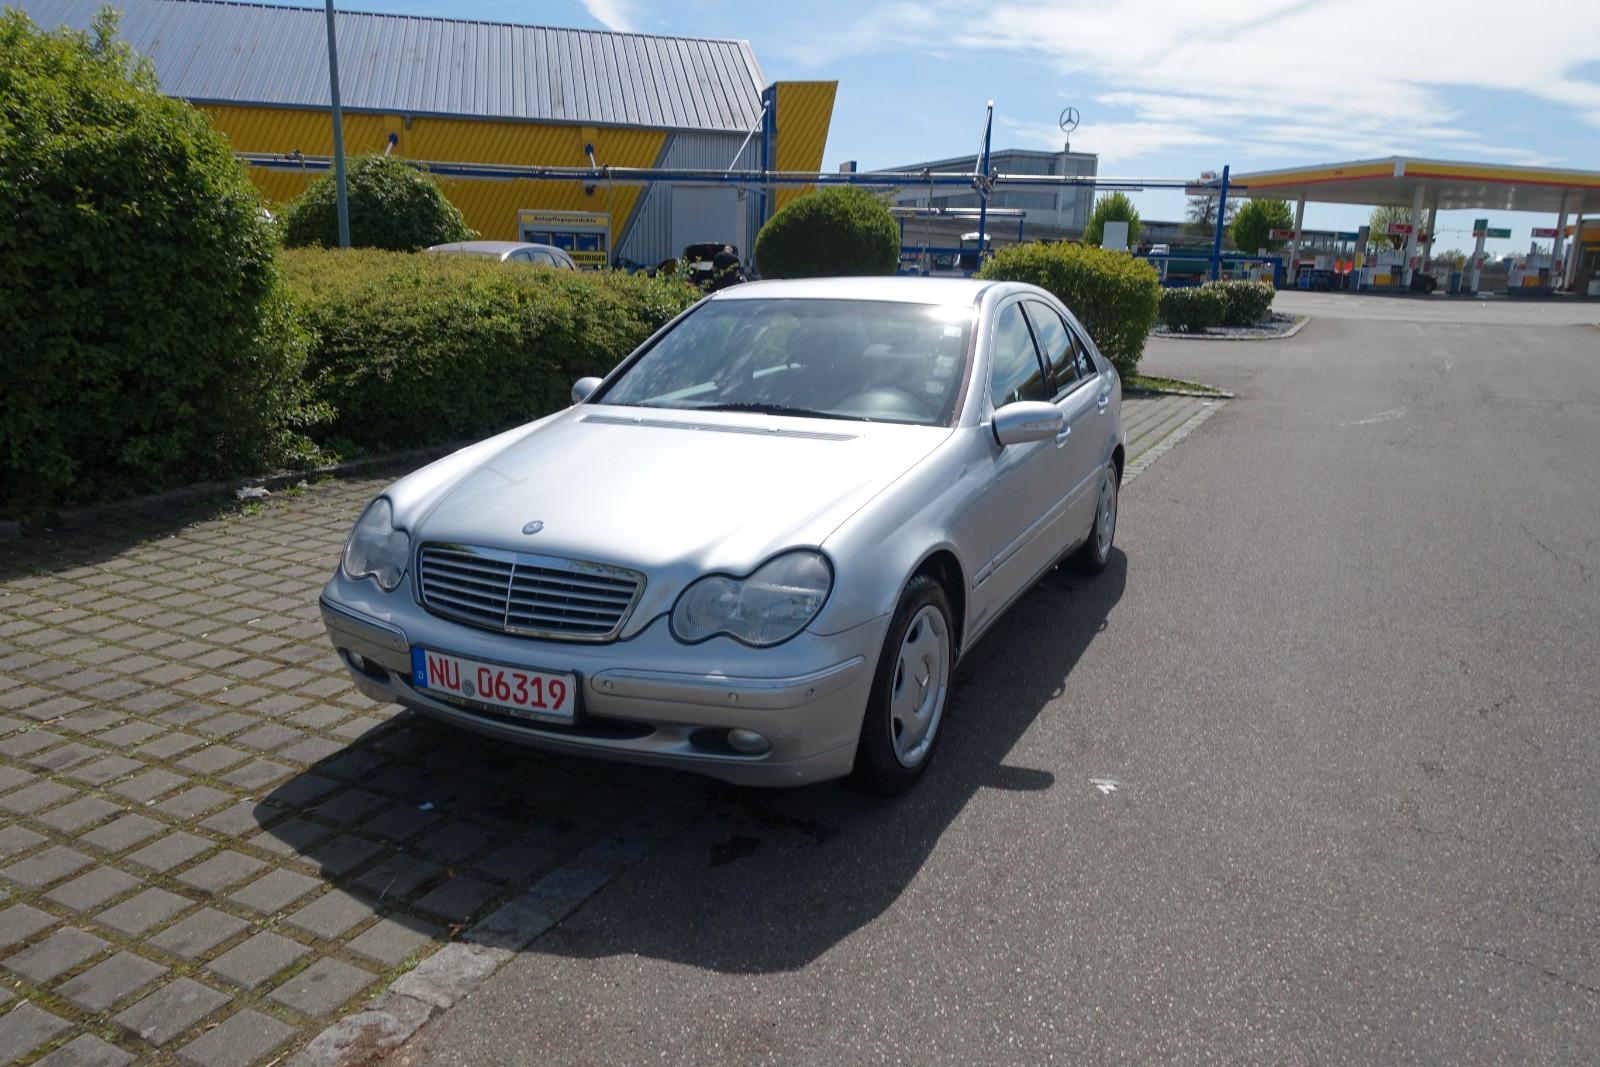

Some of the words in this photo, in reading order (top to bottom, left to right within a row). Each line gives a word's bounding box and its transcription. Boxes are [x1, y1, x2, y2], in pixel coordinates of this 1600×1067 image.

[418, 671, 424, 680] D
[428, 655, 460, 691] NU
[477, 667, 566, 710] 06319
